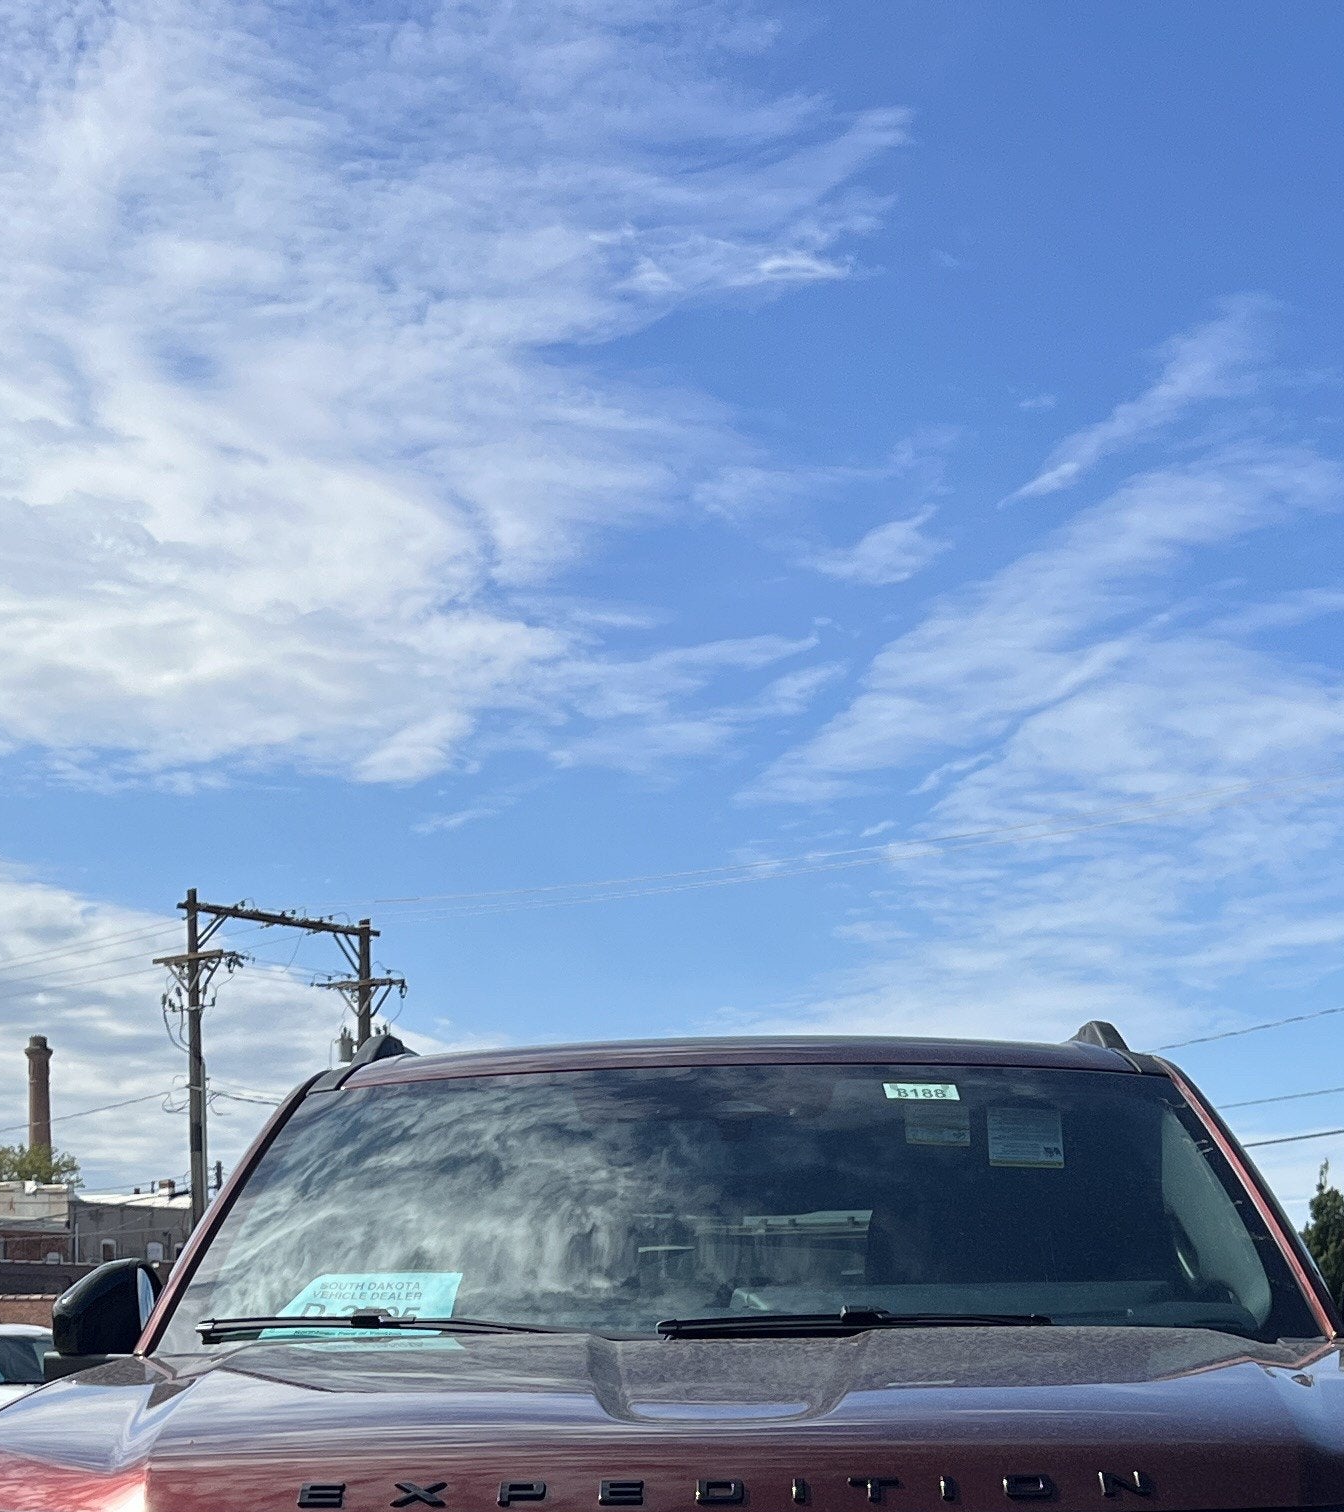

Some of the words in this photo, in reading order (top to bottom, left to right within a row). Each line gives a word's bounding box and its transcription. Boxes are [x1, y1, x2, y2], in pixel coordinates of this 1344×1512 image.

[319, 1281, 365, 1290] SOUTH
[367, 1281, 421, 1290] DAKOTA
[311, 1290, 368, 1300] VEHICLE
[369, 1291, 423, 1300] DEALER
[296, 1471, 1153, 1508] EXPEDITION
